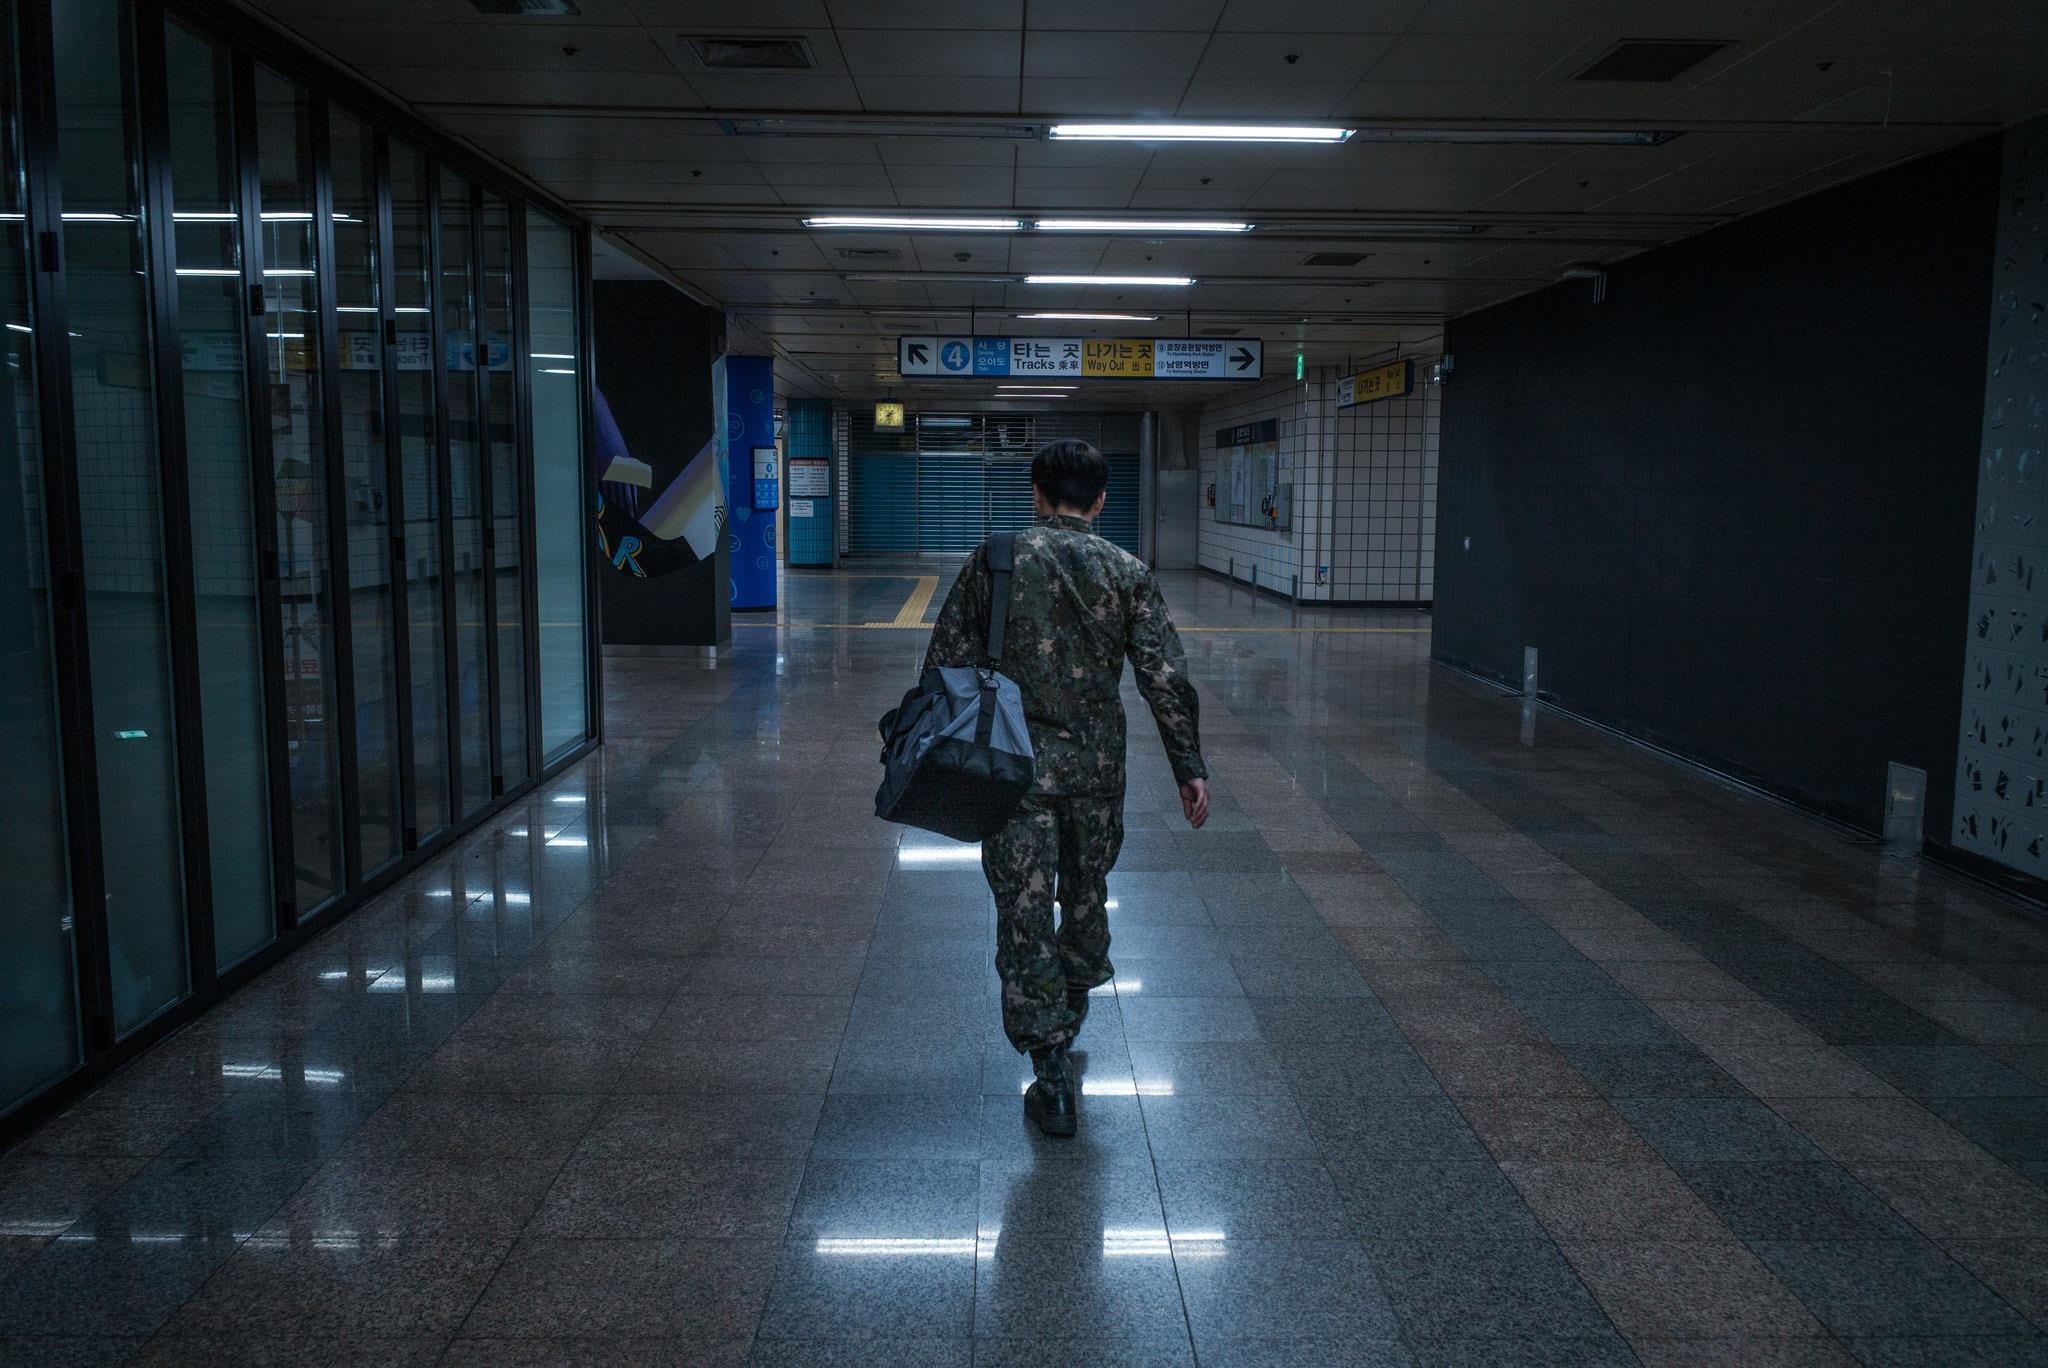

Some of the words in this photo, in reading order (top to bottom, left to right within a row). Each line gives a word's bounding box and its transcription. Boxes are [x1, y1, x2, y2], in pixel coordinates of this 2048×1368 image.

[948, 344, 964, 367] 4
[1014, 343, 1050, 358] 타는
[1062, 343, 1079, 358] 곳
[1087, 343, 1132, 358] 나가는
[1138, 344, 1152, 358] 곳
[977, 357, 1006, 366] 오이도
[1014, 358, 1055, 370] Tracks
[1088, 359, 1107, 372] Way
[1109, 359, 1124, 370] Out
[1166, 360, 1209, 369] 남영역방면
